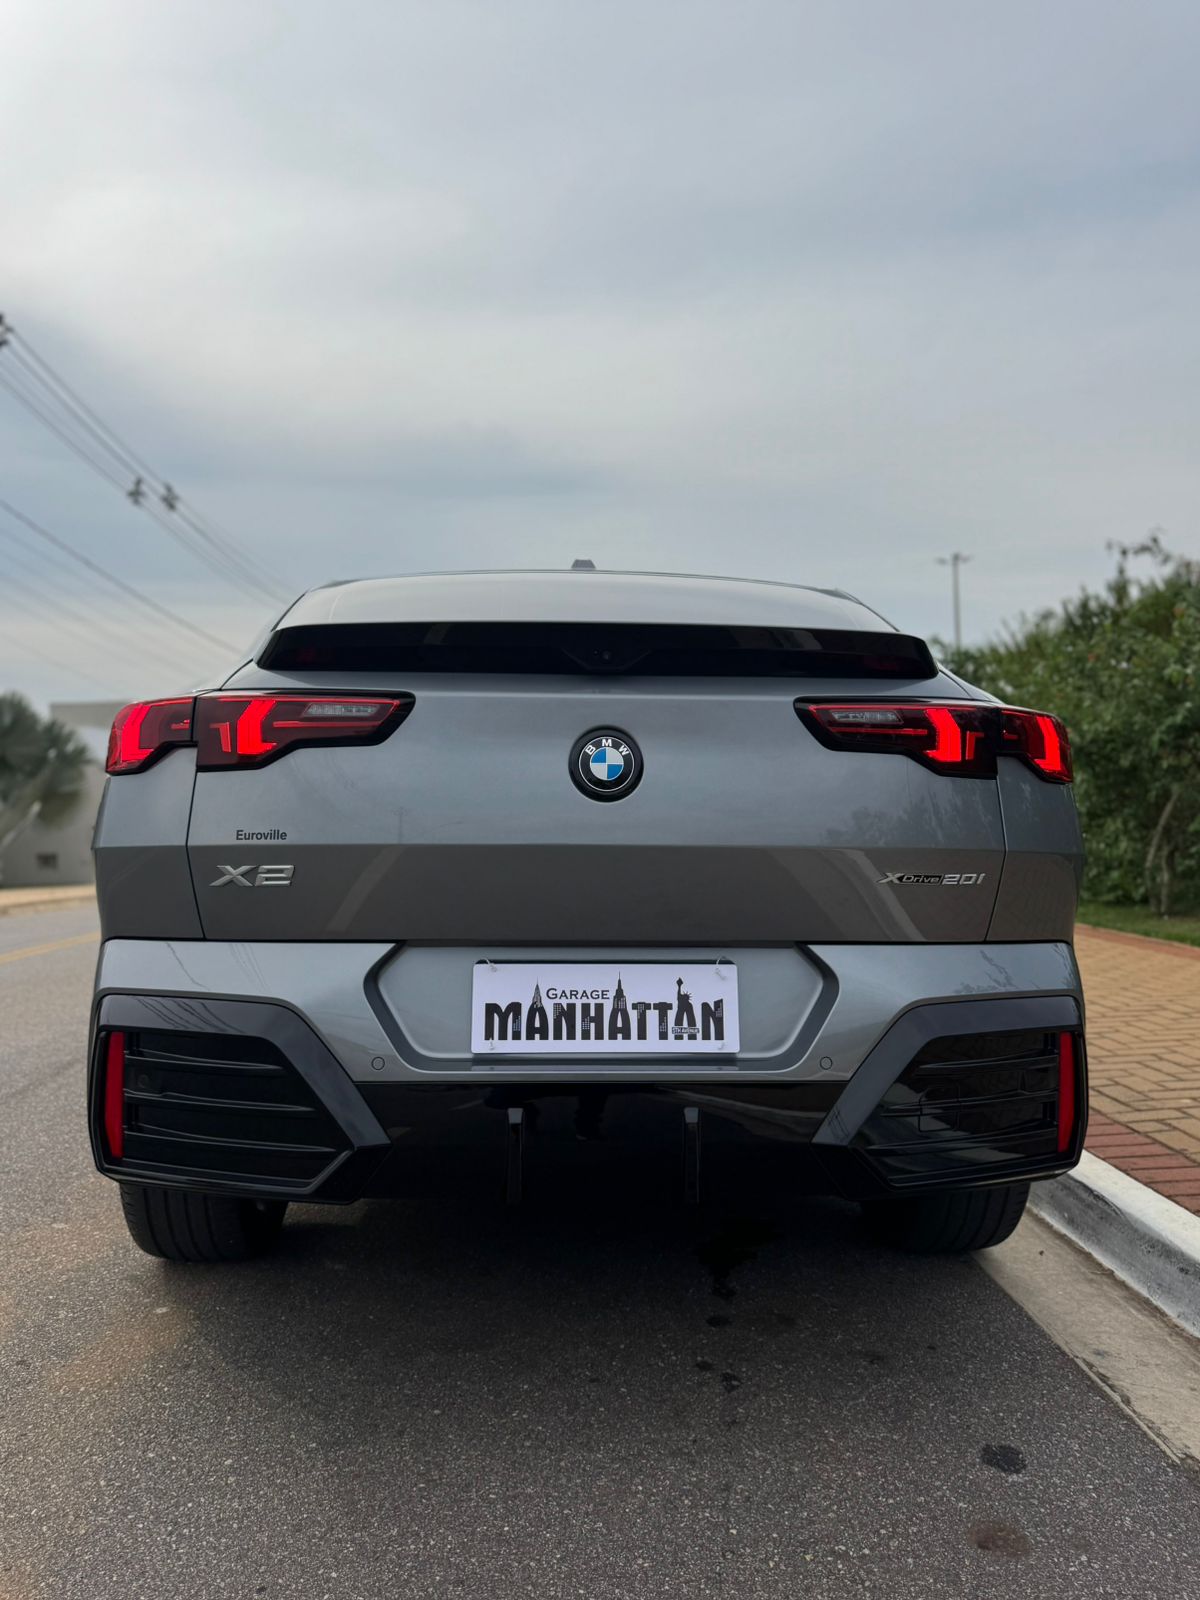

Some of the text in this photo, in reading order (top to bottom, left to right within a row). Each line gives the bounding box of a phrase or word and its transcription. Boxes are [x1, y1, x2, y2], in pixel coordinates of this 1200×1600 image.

[585, 738, 630, 756] BMW
[235, 829, 288, 841] Euroville
[208, 864, 295, 887] X2
[484, 997, 724, 1041] MANHATTAN
